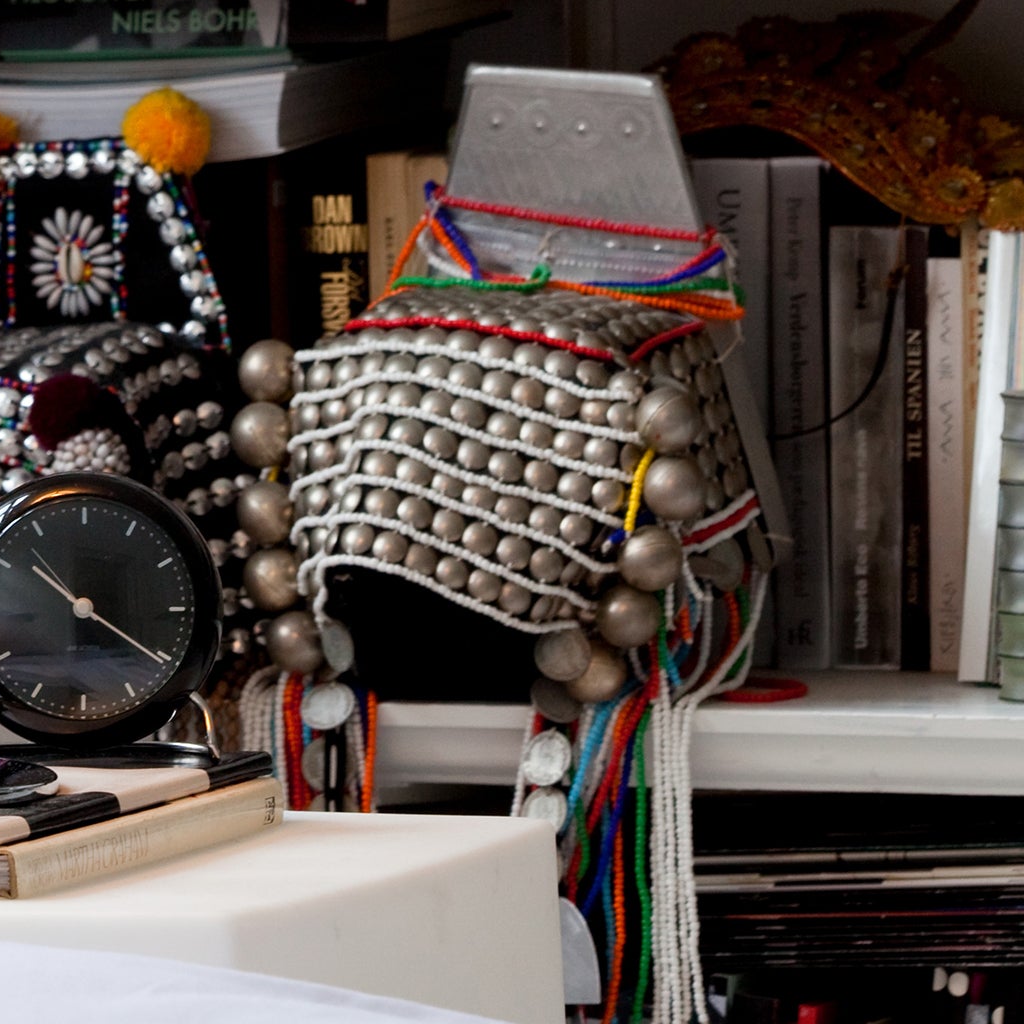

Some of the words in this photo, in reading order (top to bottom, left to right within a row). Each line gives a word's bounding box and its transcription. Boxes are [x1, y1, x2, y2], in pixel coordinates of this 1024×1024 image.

[111, 8, 182, 34] NIELS
[187, 5, 261, 32] BOHR
[312, 194, 353, 225] DAN
[305, 223, 367, 254] ROWN
[905, 329, 923, 423] SPANIEN
[905, 426, 923, 462] TIL
[854, 545, 869, 576] Eco
[854, 579, 869, 650] Umberto
